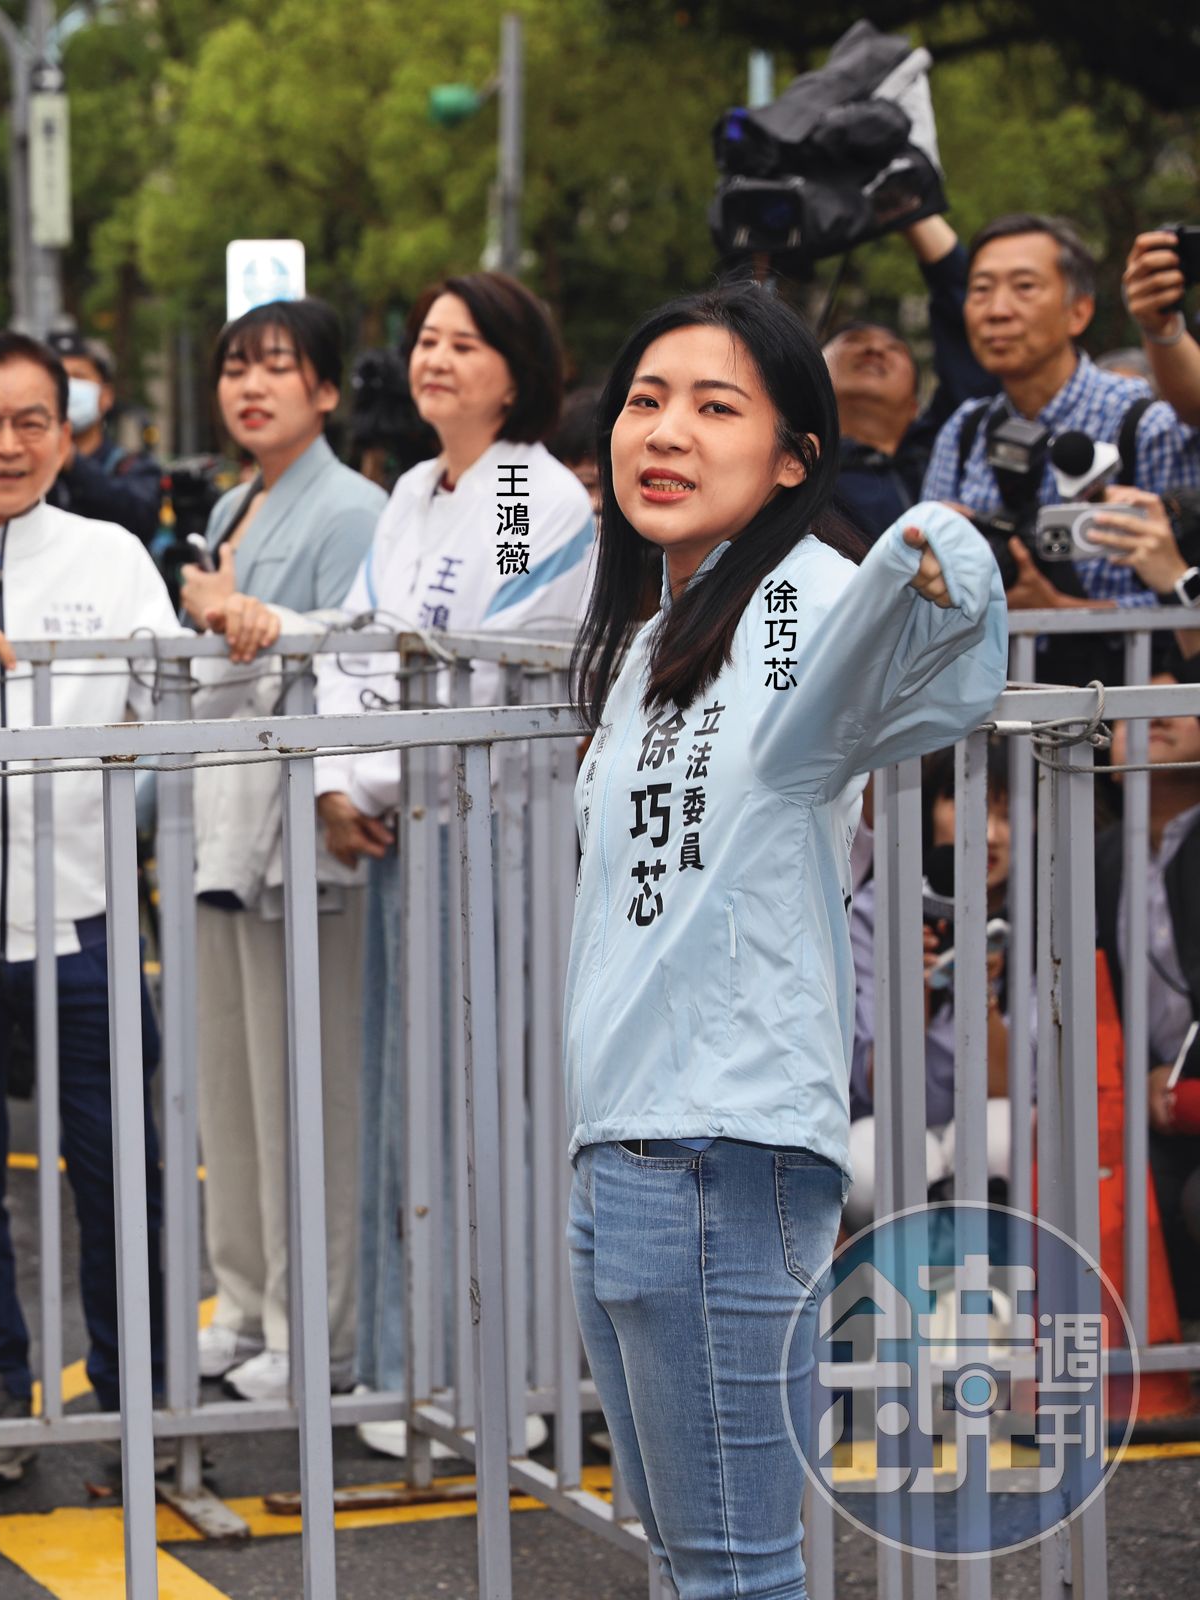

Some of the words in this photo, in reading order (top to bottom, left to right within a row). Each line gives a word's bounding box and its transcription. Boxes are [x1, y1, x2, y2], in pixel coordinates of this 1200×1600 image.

[627, 709, 687, 926] 徐巧芯
[678, 700, 726, 872] 立法委員
